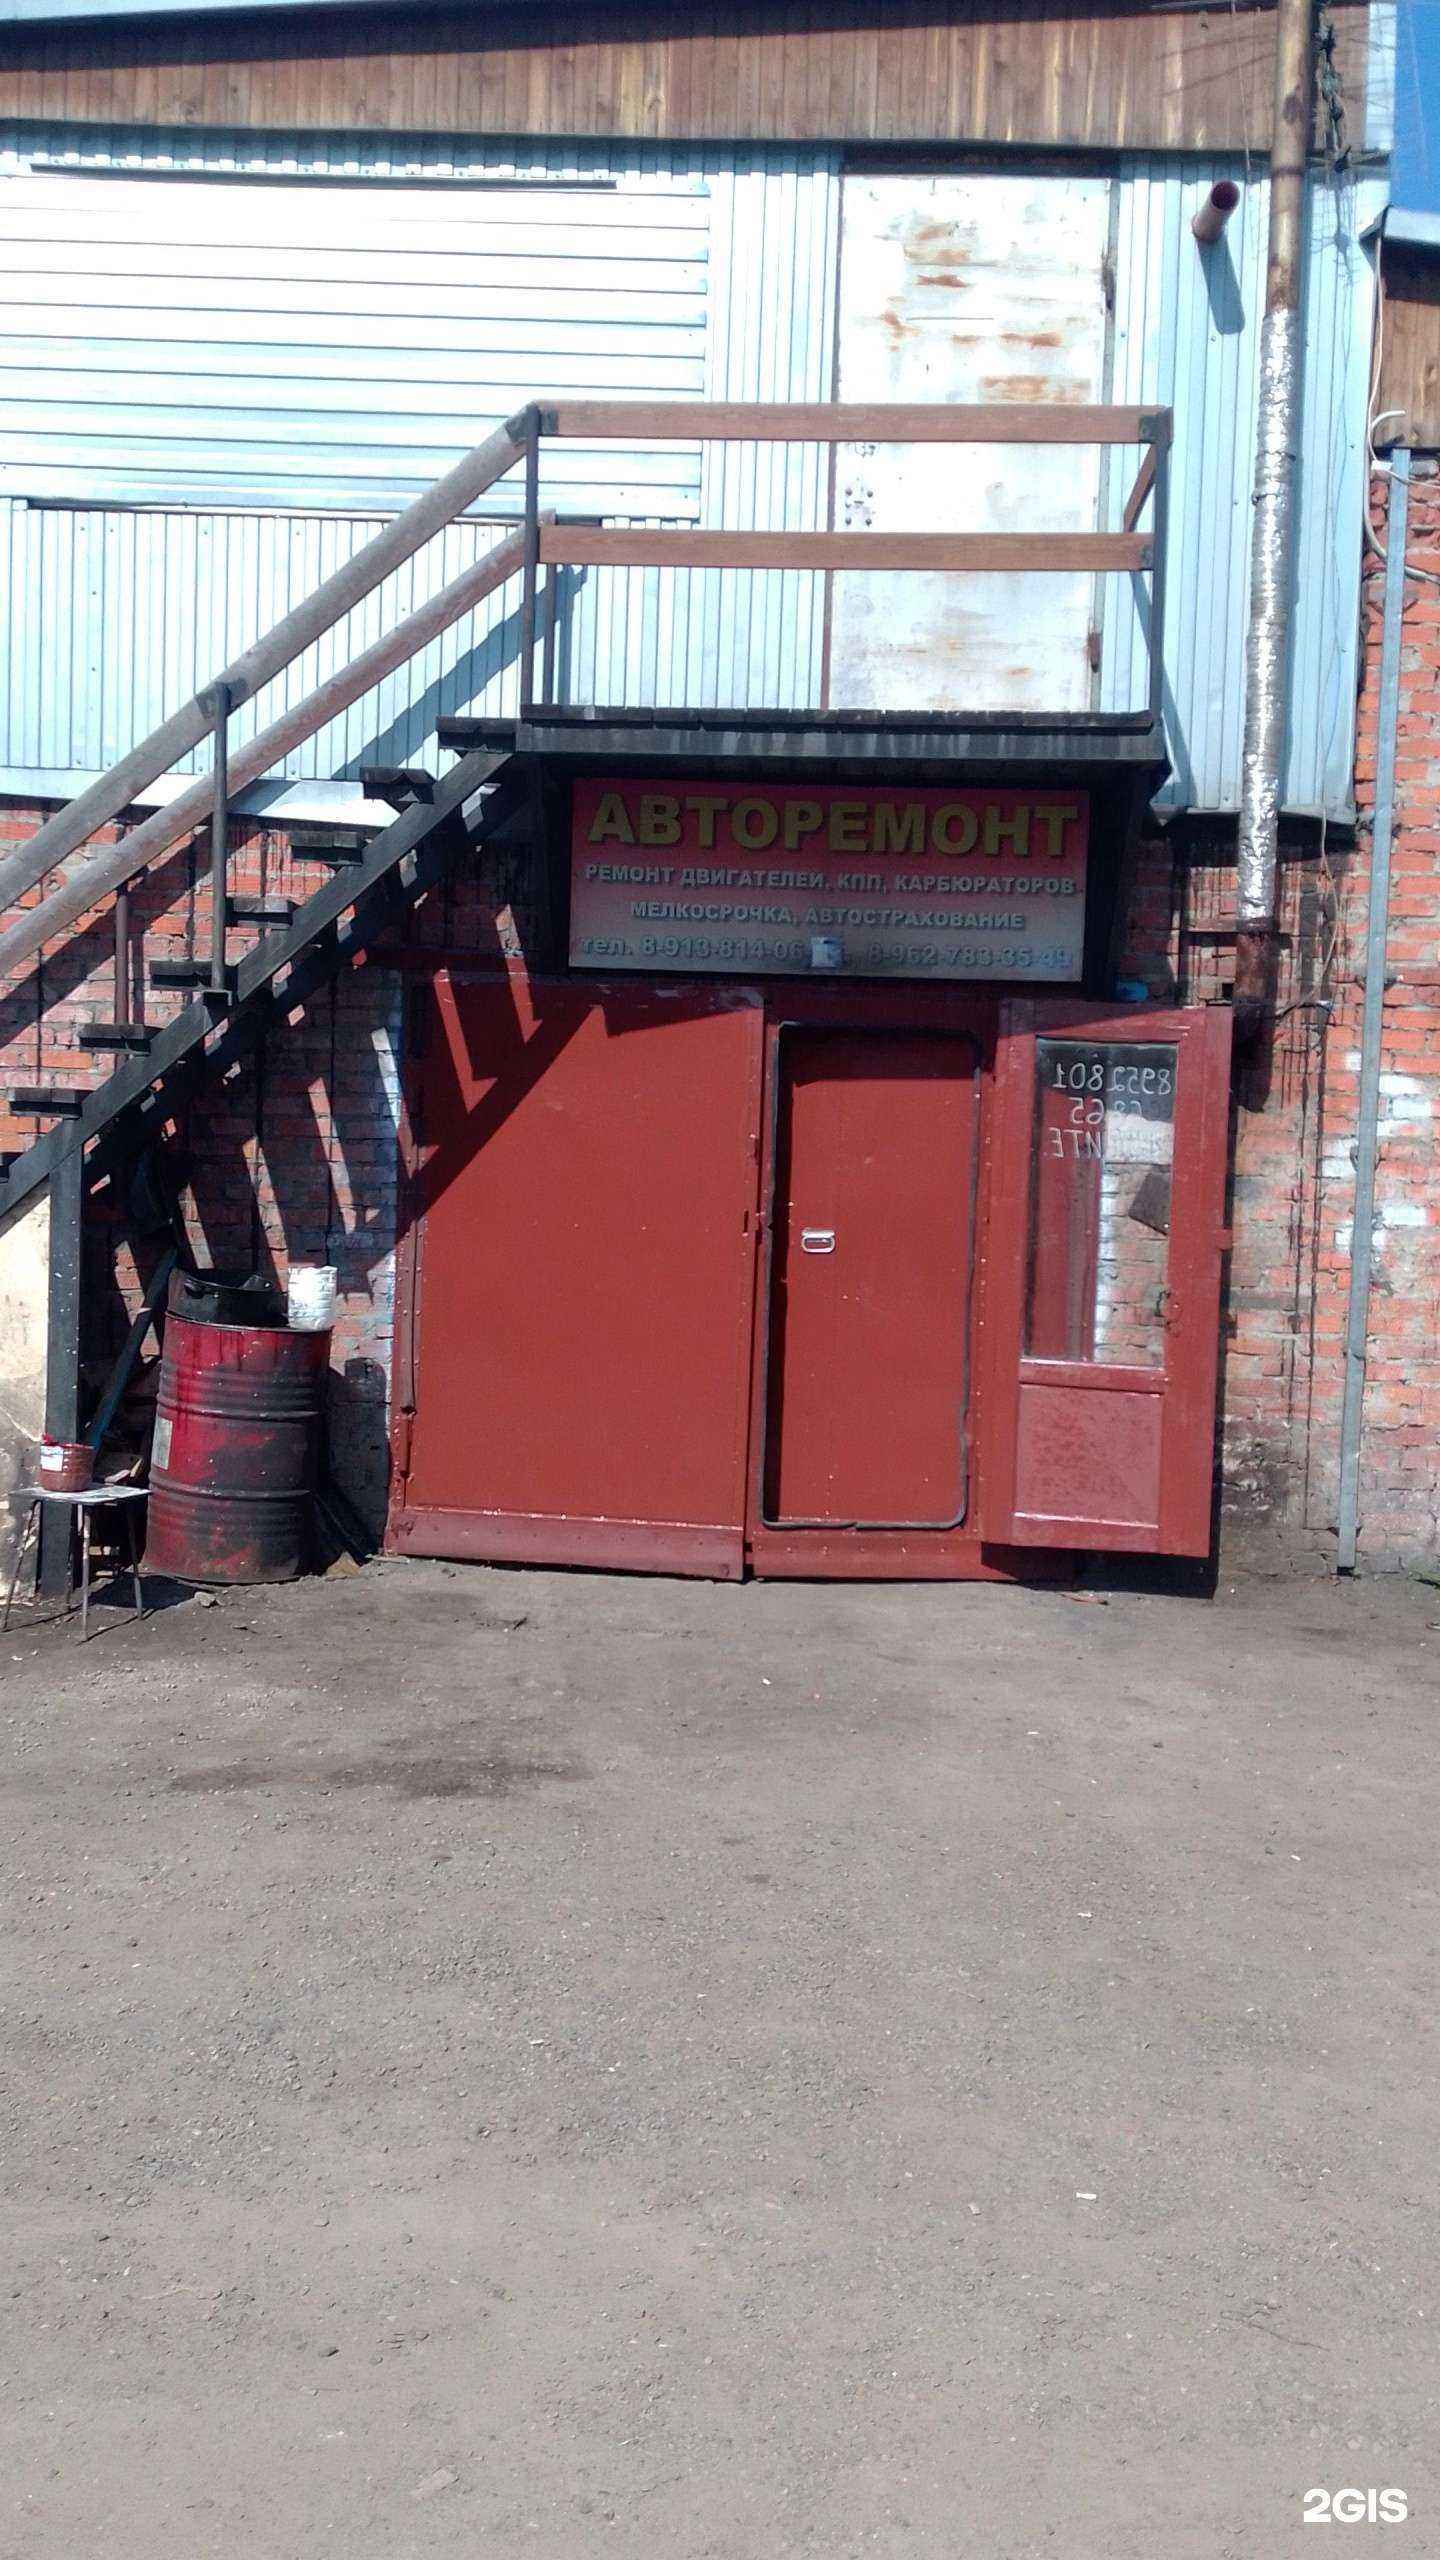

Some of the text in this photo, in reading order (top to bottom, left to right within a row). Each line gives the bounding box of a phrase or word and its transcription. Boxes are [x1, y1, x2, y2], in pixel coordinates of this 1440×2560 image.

[587, 792, 1079, 857] АВТОРЕМОНТ
[583, 862, 676, 886] РЕМОНТ
[894, 874, 1075, 896] КАРБЮРАТОРОВ
[804, 905, 1026, 930] АВТОСТРАХОВАНИЕ
[580, 936, 633, 957] тел.
